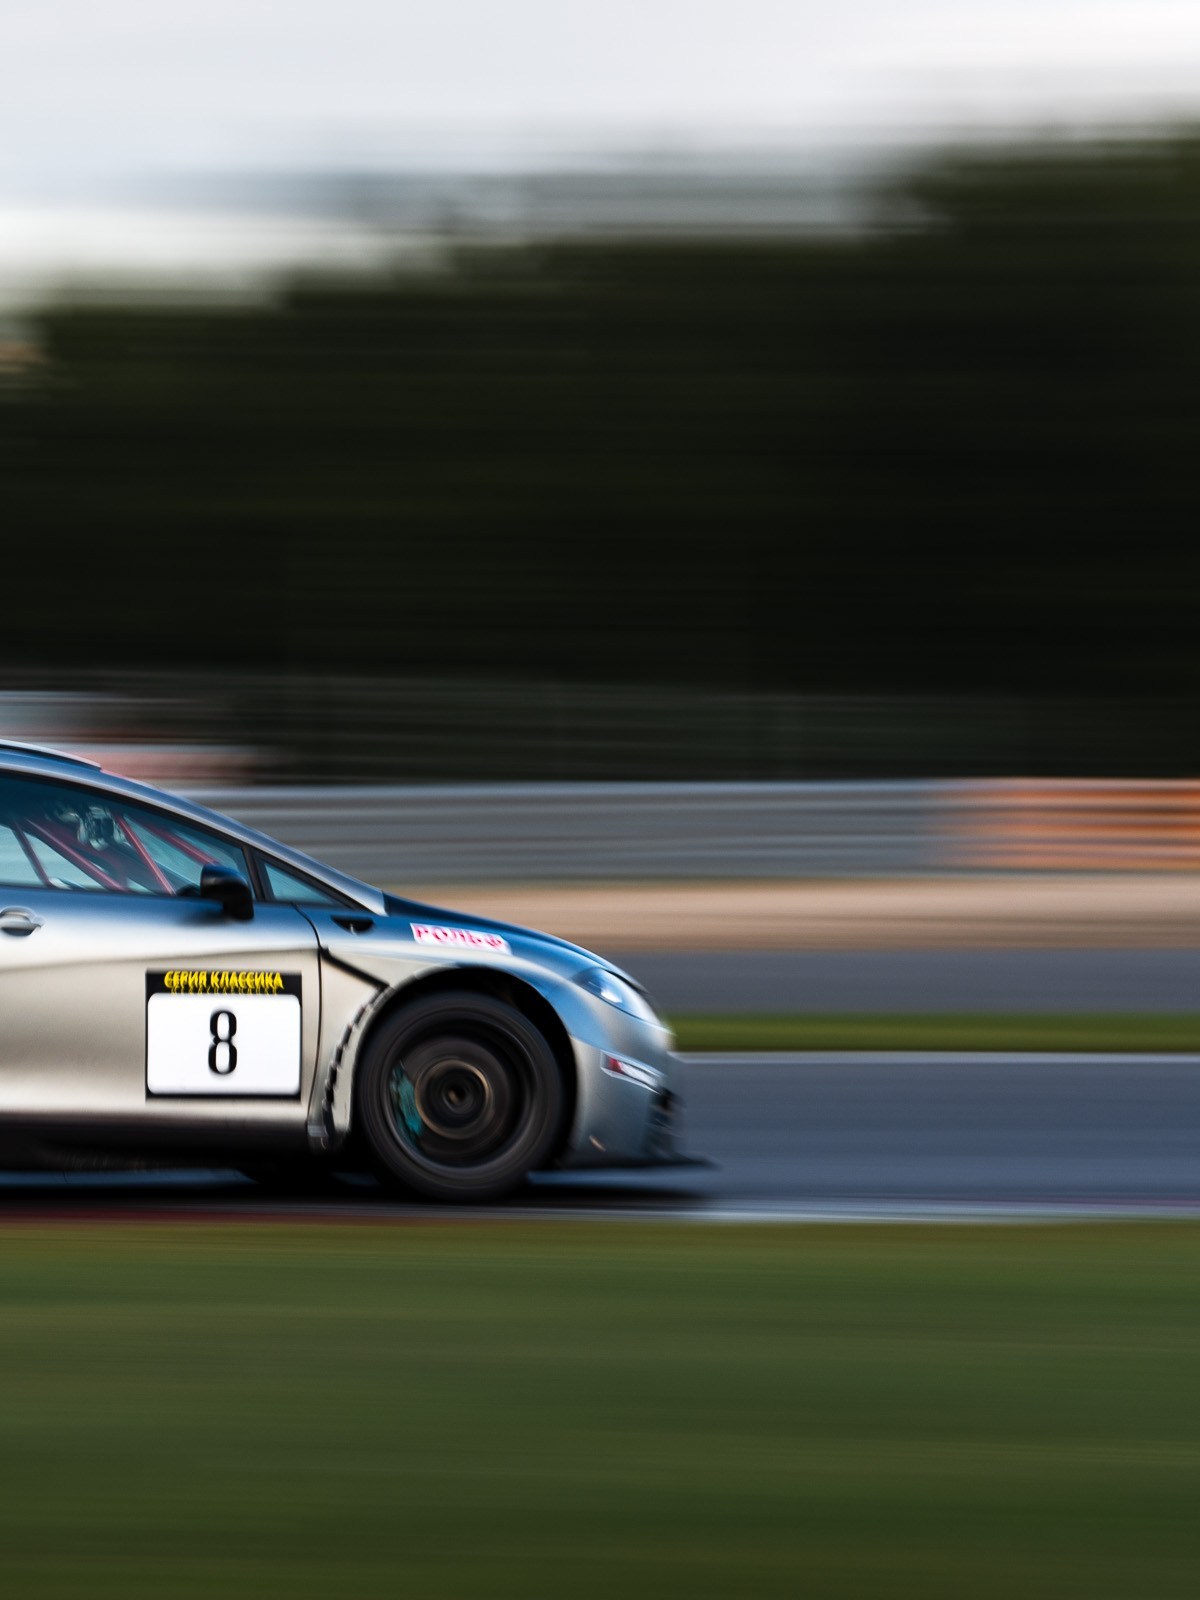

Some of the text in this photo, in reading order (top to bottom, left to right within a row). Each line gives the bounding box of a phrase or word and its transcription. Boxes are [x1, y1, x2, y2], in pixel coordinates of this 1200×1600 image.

[413, 925, 503, 950] РОЛЬФ
[164, 971, 284, 990] СЕРИЯ КЛАССИКА
[208, 1007, 238, 1076] 8
